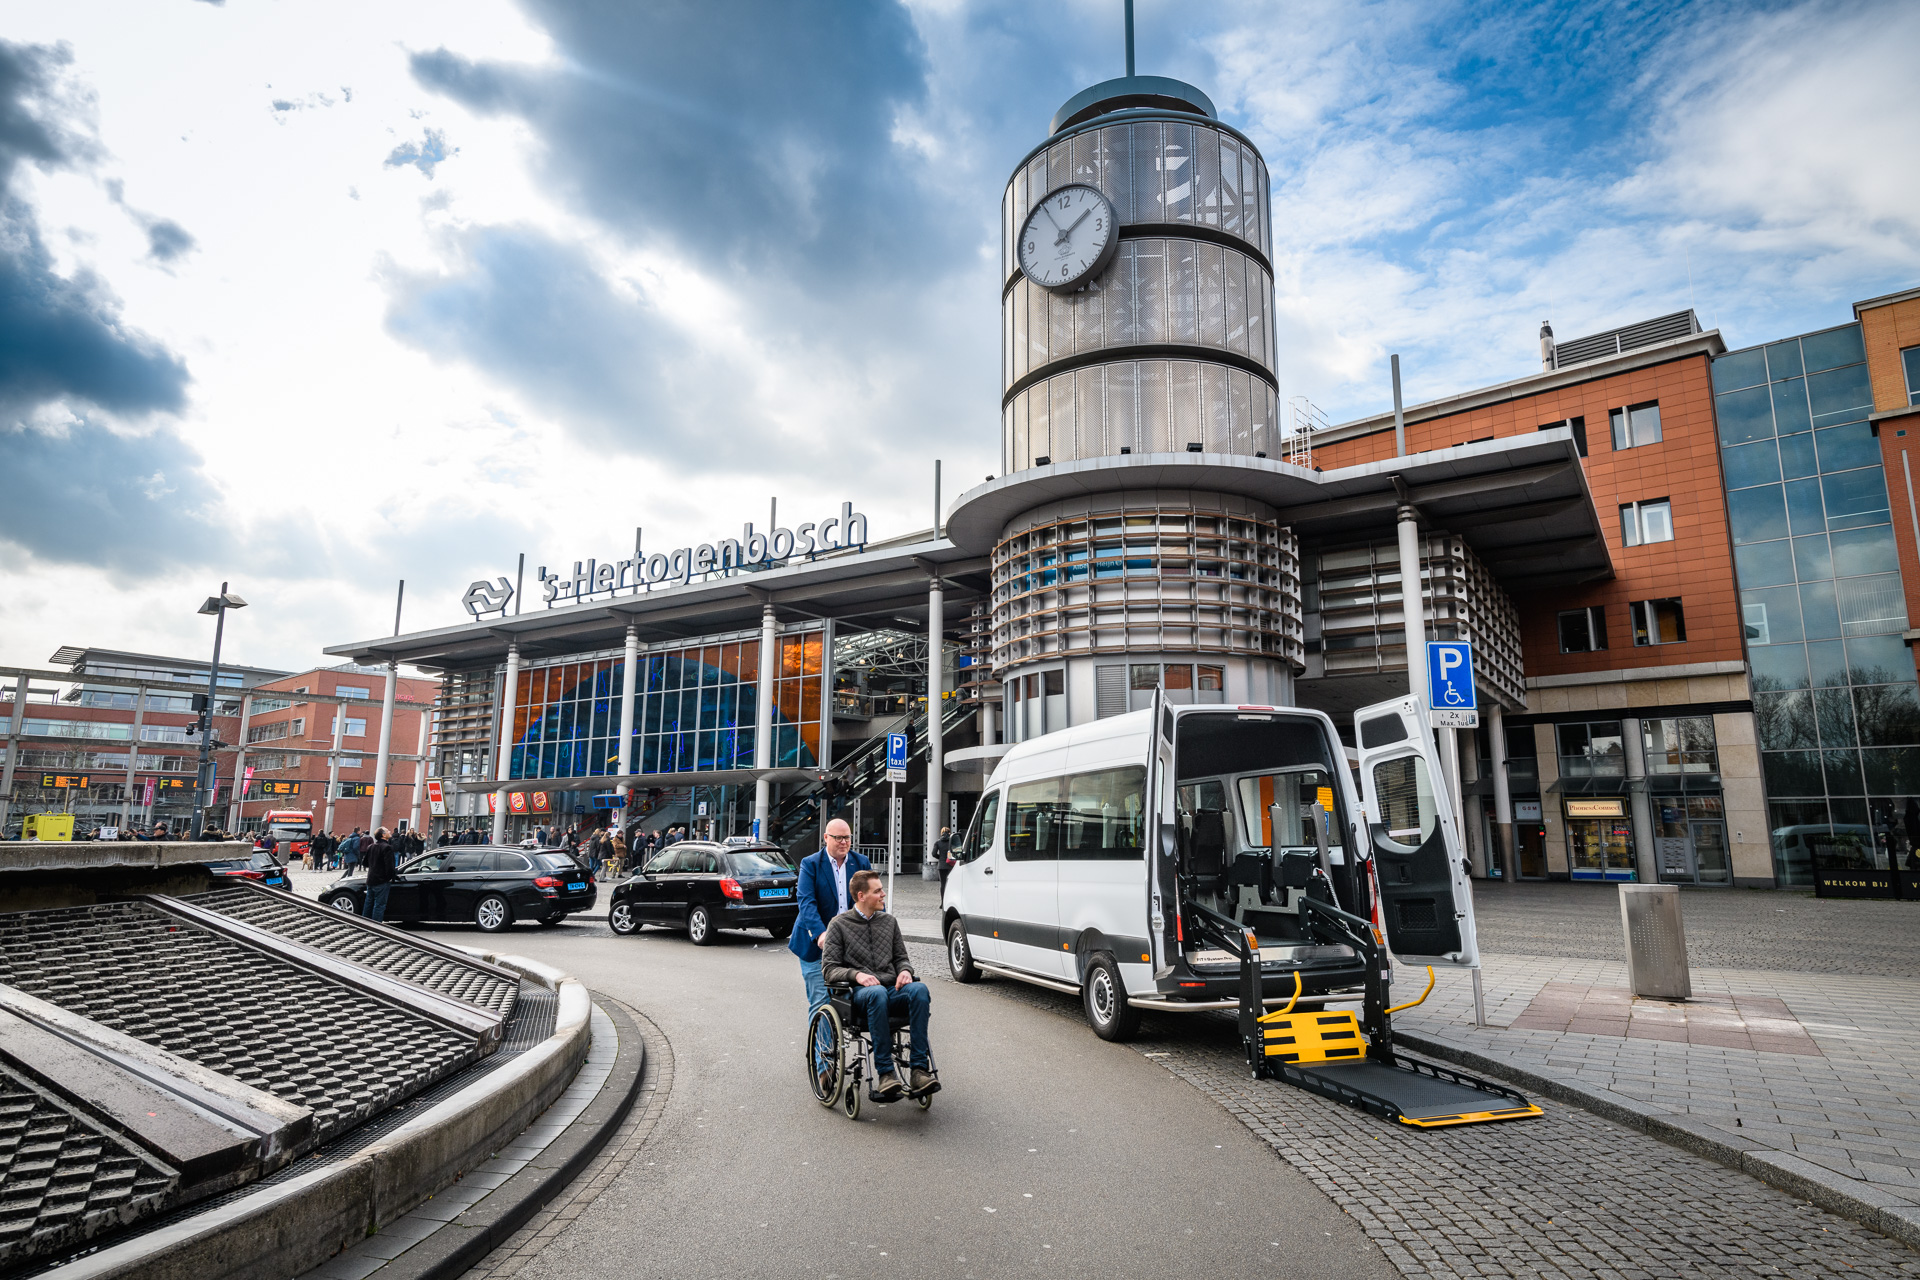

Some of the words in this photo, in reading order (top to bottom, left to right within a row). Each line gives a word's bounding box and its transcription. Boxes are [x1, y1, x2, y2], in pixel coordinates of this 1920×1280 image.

[1057, 195, 1071, 210] 12
[1095, 217, 1103, 232] 3
[1027, 241, 1035, 255] 9
[1061, 263, 1069, 277] 6
[538, 501, 867, 601] 's-Hertogenbosch
[1438, 647, 1463, 680] P
[1449, 711, 1460, 719] 2x
[892, 736, 904, 755] P
[890, 757, 905, 766] taxi
[43, 775, 54, 787] E
[160, 779, 170, 790] F
[263, 782, 273, 793] G
[355, 785, 363, 795] H
[1823, 879, 1867, 888] WELKOM
